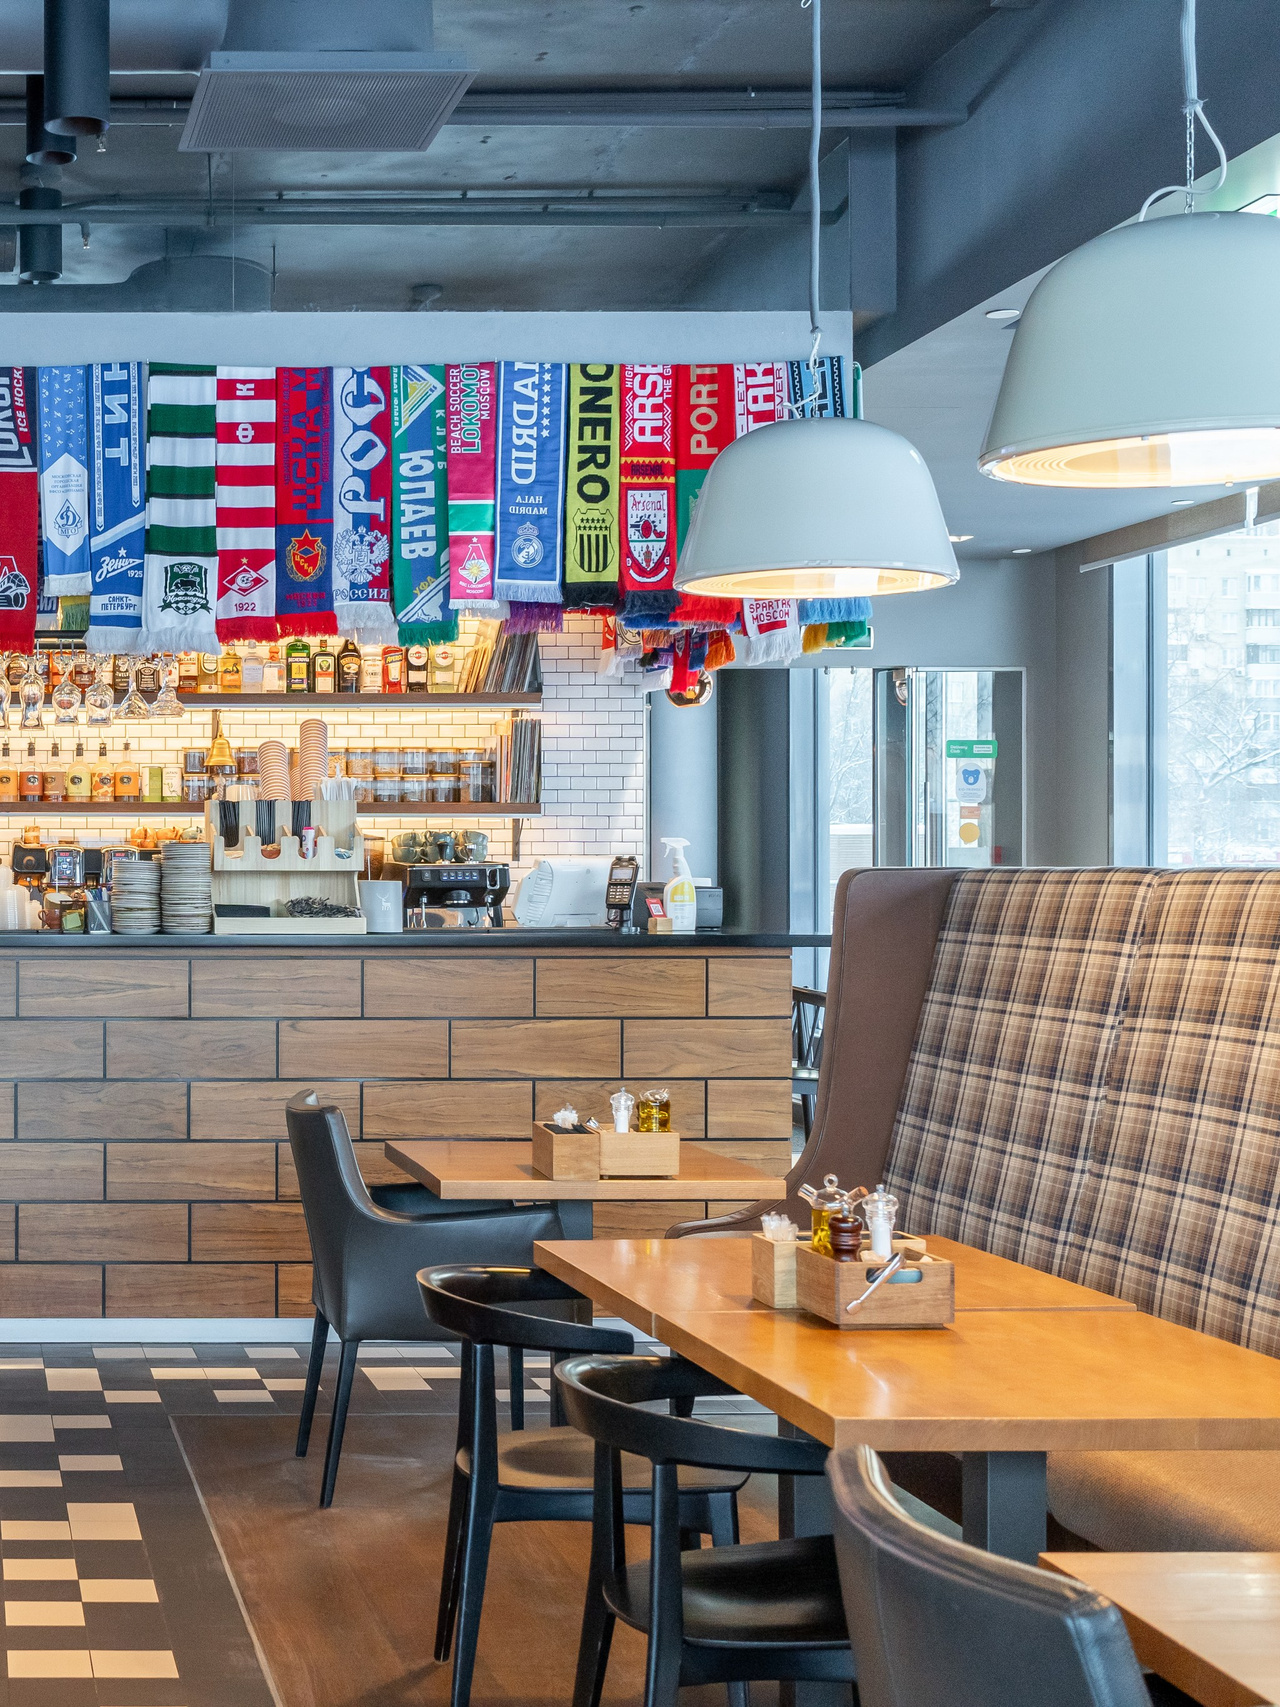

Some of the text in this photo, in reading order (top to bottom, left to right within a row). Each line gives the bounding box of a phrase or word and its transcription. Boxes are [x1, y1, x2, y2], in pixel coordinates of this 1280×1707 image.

[480, 369, 491, 420] MOSCOW
[663, 378, 672, 399] THE
[16, 410, 28, 432] ICE
[449, 368, 462, 454] BEACH SOCCER
[339, 367, 388, 521] РОС
[291, 411, 323, 510] ЦСКА
[630, 464, 665, 476] ARSENAL
[399, 449, 437, 560] ЮЛАЕВ
[630, 492, 666, 512] Arsenal
[294, 553, 313, 573] ЦСКА
[127, 570, 143, 578] 1925
[333, 588, 390, 601] РОССИЯ
[413, 575, 437, 597] УФА
[101, 602, 138, 611] ПЕТЕРБУРГ
[108, 595, 132, 603] САНКТ-
[234, 602, 257, 612] 1922
[748, 599, 792, 613] SPARTAK
[751, 611, 790, 625] MOSCOW
